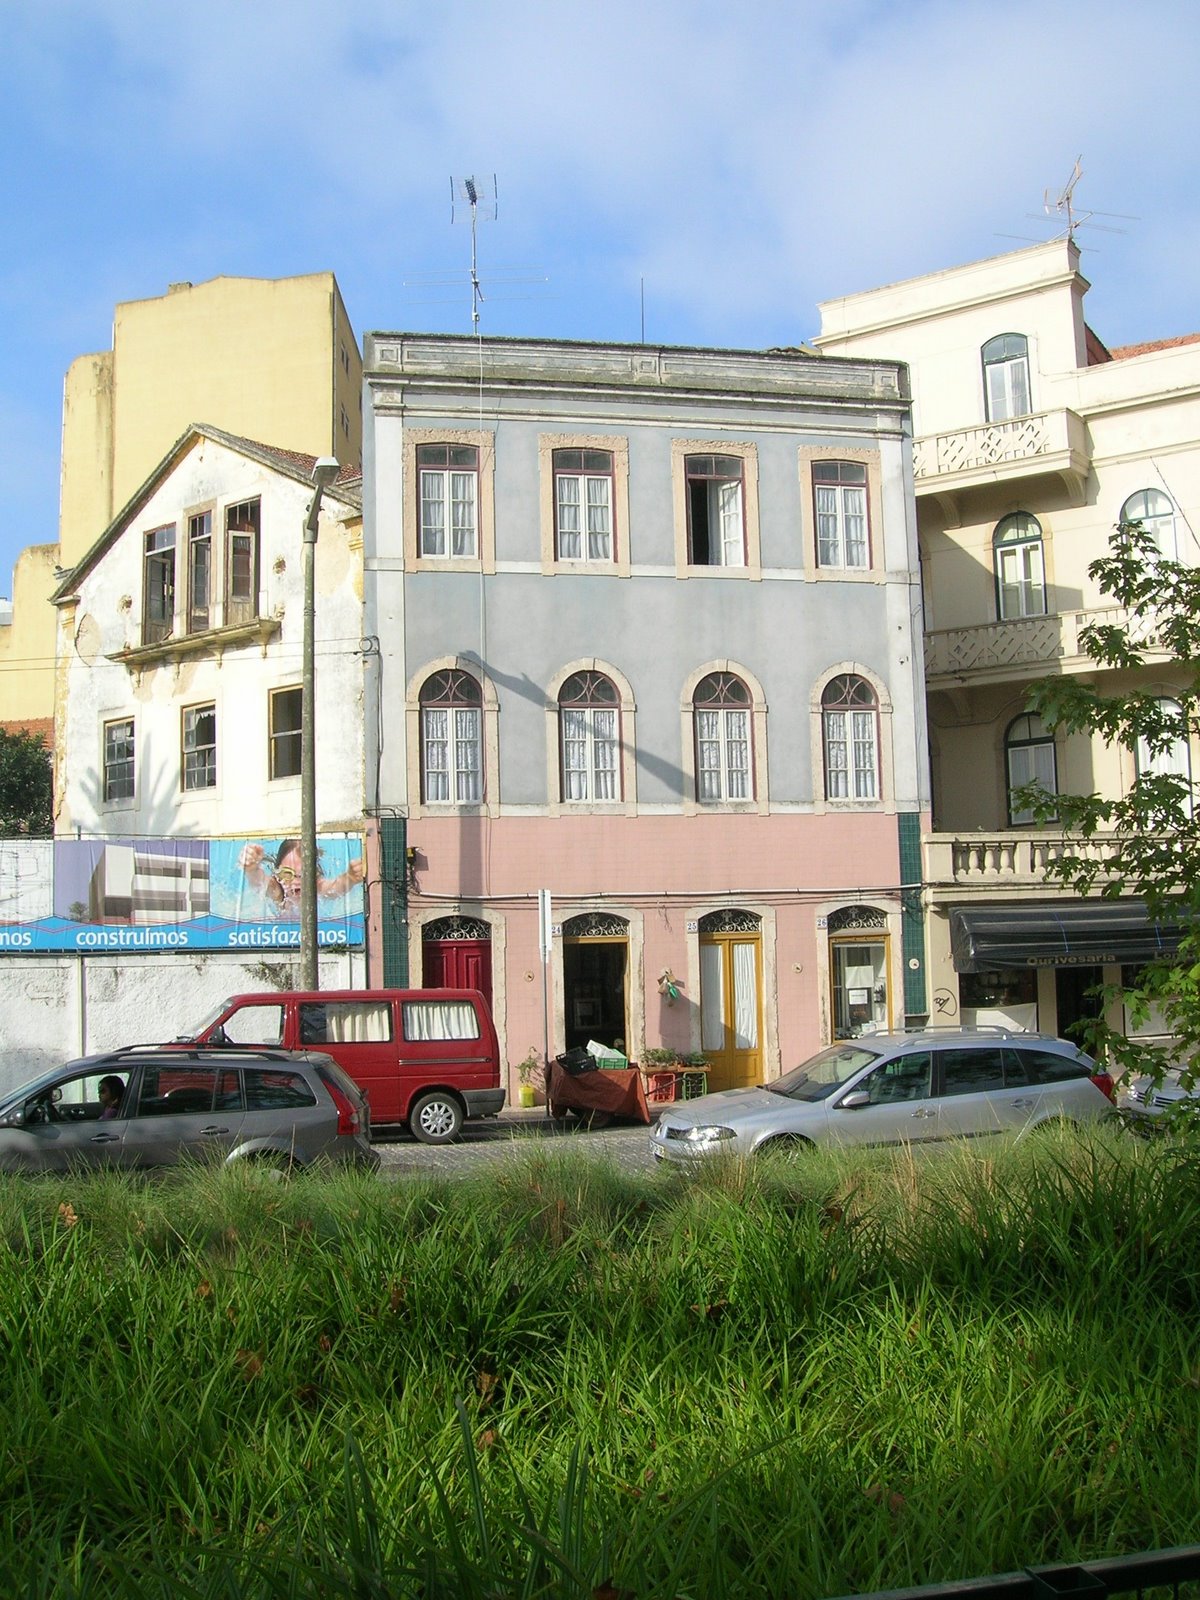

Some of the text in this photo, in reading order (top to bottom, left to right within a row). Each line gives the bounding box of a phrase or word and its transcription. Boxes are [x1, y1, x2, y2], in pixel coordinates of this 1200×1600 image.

[687, 922, 697, 931] 25
[817, 918, 827, 927] 26
[228, 925, 347, 946] satisfazos
[551, 926, 561, 934] 24
[76, 927, 188, 946] construímos
[1026, 953, 1116, 966] Ourivesaria
